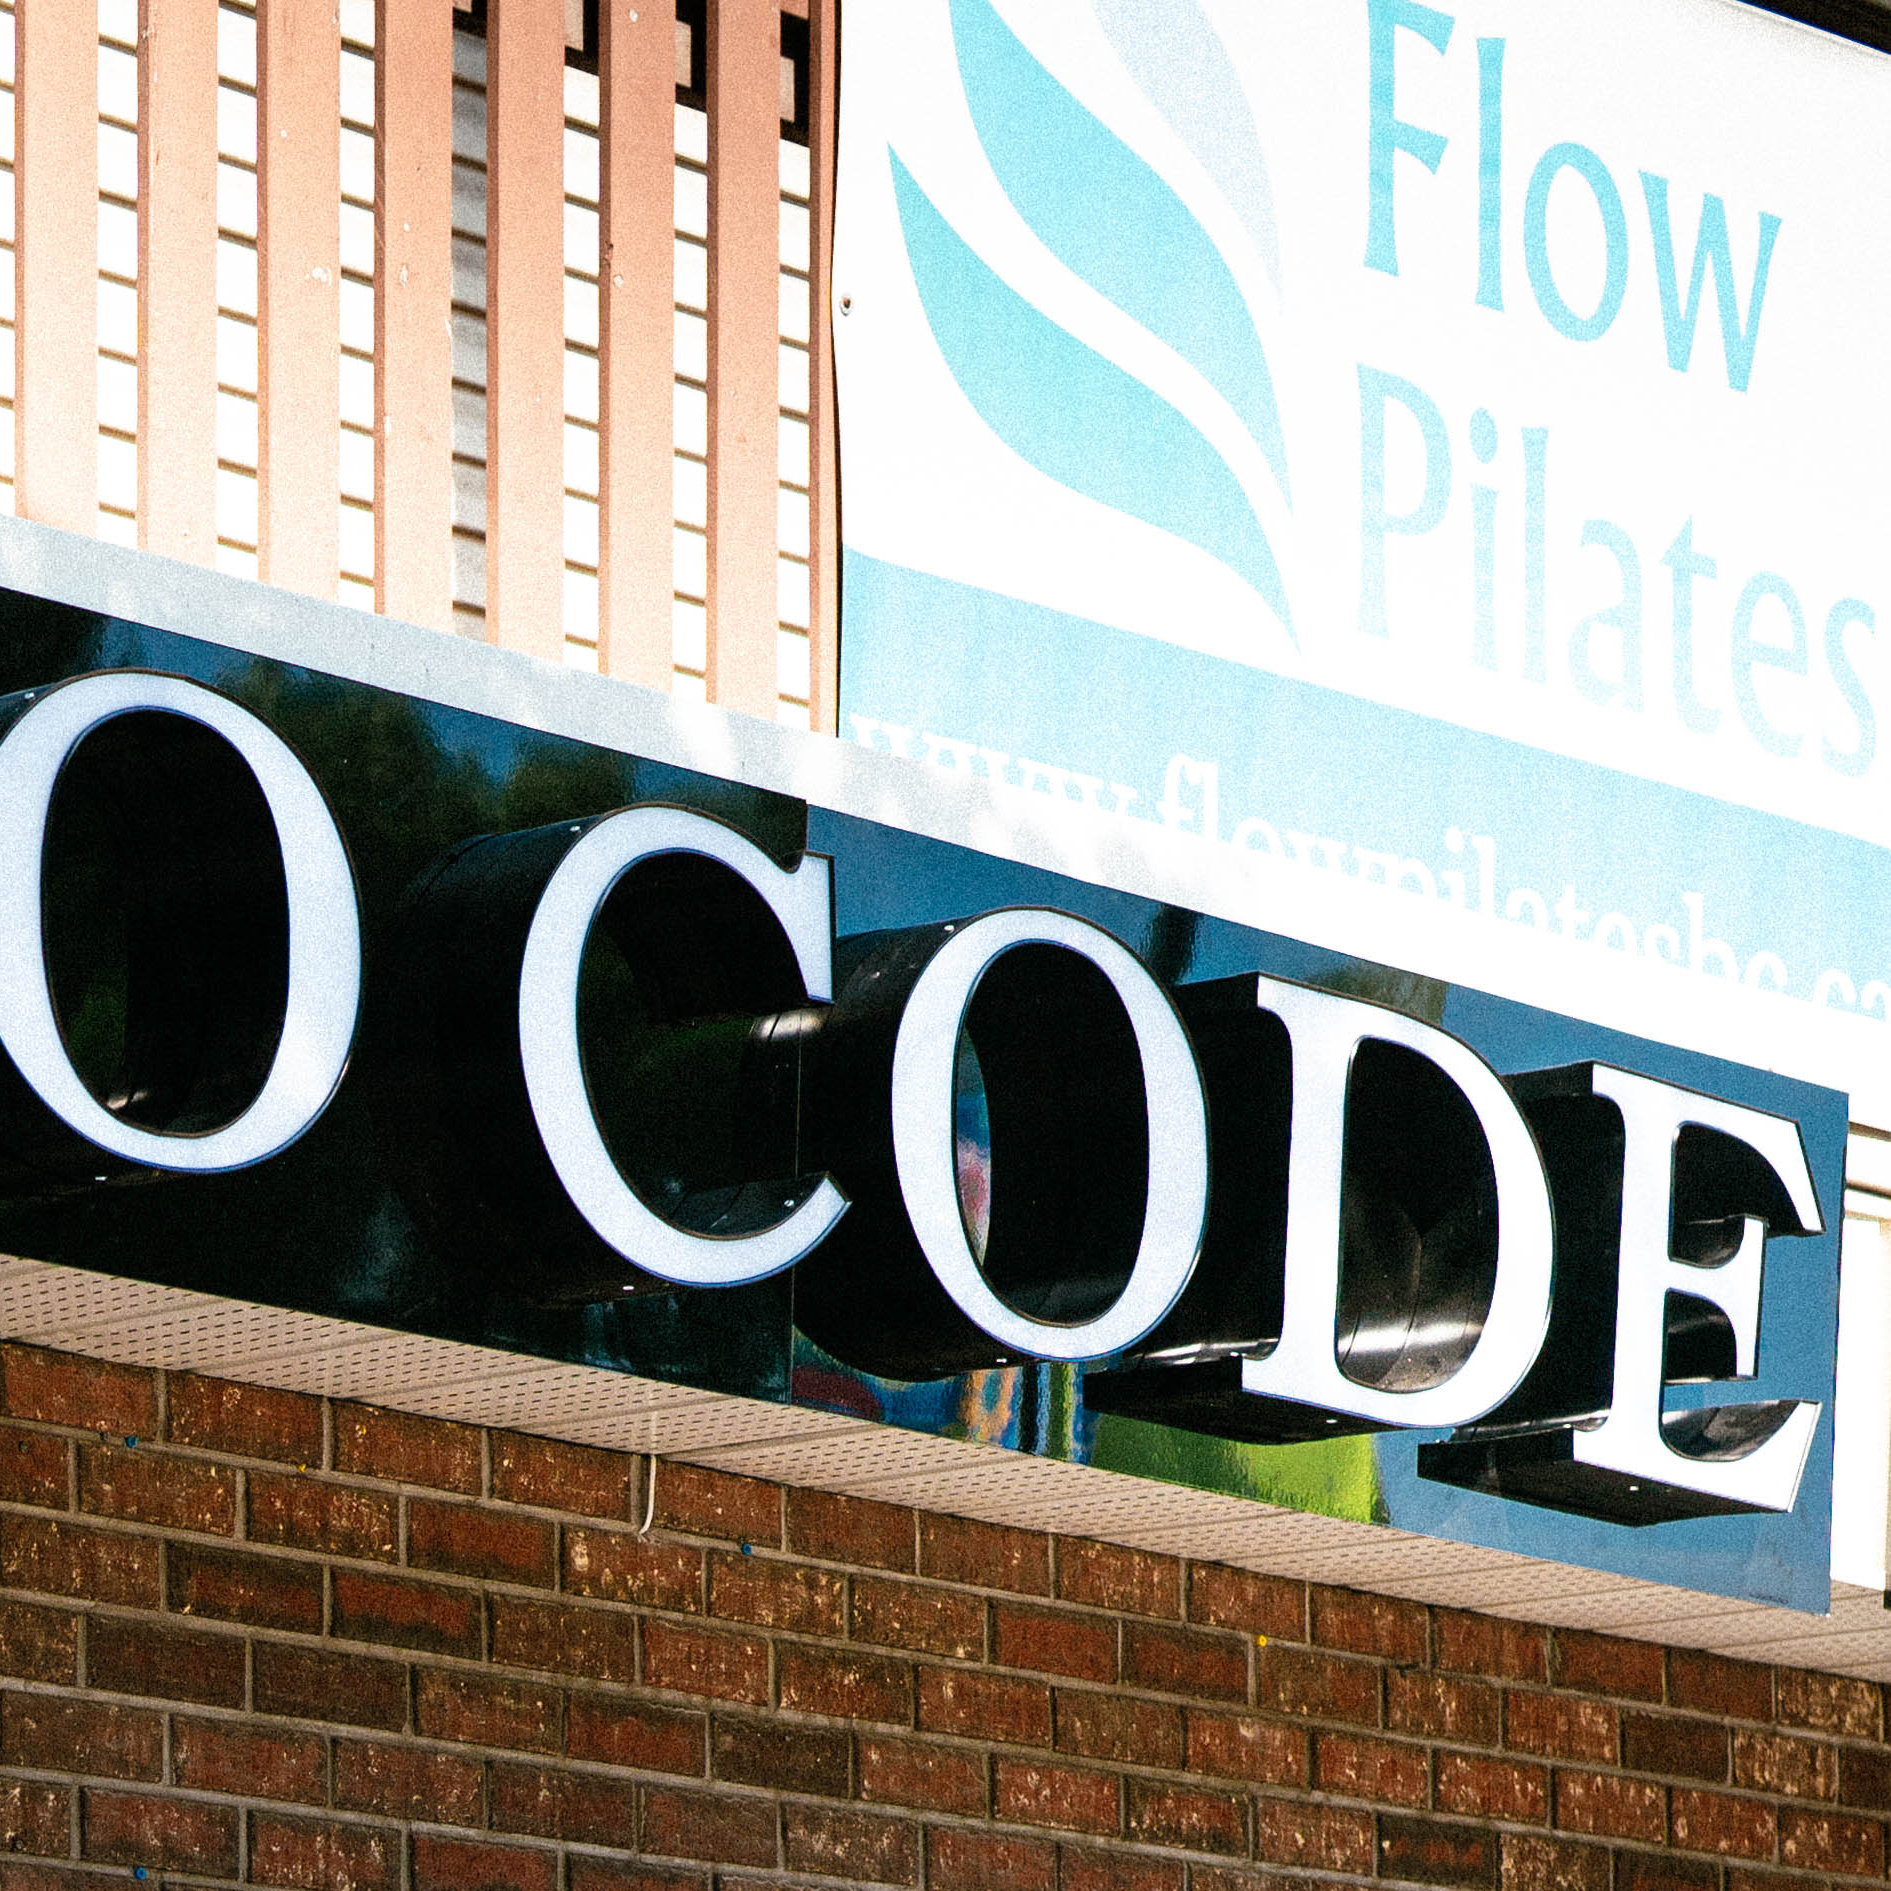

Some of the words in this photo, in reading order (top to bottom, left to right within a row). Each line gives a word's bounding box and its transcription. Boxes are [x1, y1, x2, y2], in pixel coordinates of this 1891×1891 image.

[1363, 0, 1784, 393] Flow
[1356, 362, 1879, 777] Pilates
[518, 801, 1825, 1514] CODE
